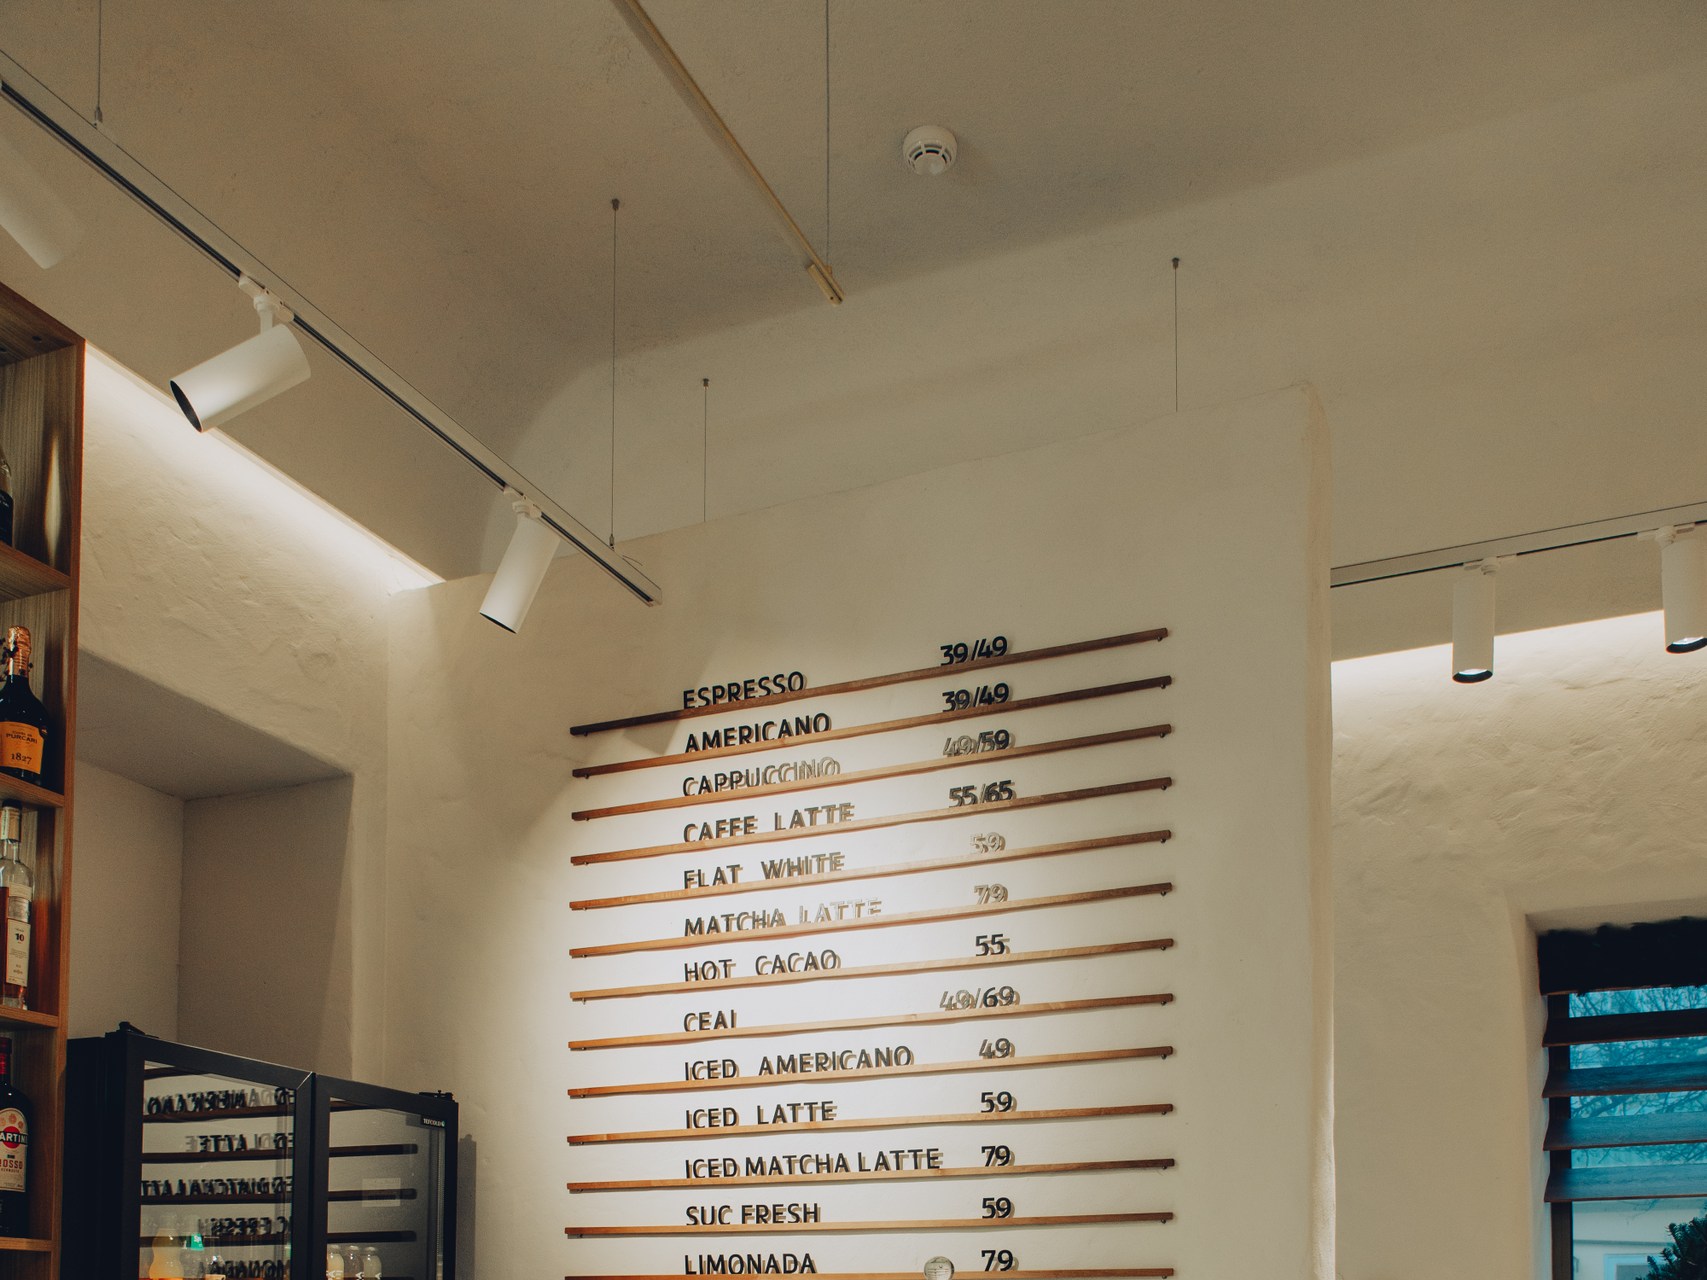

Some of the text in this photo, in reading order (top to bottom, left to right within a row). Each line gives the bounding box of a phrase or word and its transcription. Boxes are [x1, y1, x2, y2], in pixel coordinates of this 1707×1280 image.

[683, 636, 1008, 710] ESPRESSO 39/49
[685, 683, 1009, 754] AMERICANO 39/49
[11, 752, 32, 765] 1827
[682, 729, 1010, 797] CAPPUCCINO 49/59
[683, 780, 1014, 843] CAFFE LATTE 55/65
[684, 832, 1003, 889] FLAT WHITE 59
[685, 883, 1006, 937] MATCHA LATTE 79
[684, 934, 1006, 982] HOT CACAO 55
[684, 985, 1015, 1033] CEAI 49/69
[685, 1038, 1011, 1082] ICED AMERICANO 49
[685, 1091, 1012, 1130] ICED LATTE 59
[685, 1145, 1011, 1179] ICED MATCHA LATTE 79
[686, 1197, 1012, 1226] SUC FRESH 59
[684, 1249, 1014, 1275] LIMONADA 79
